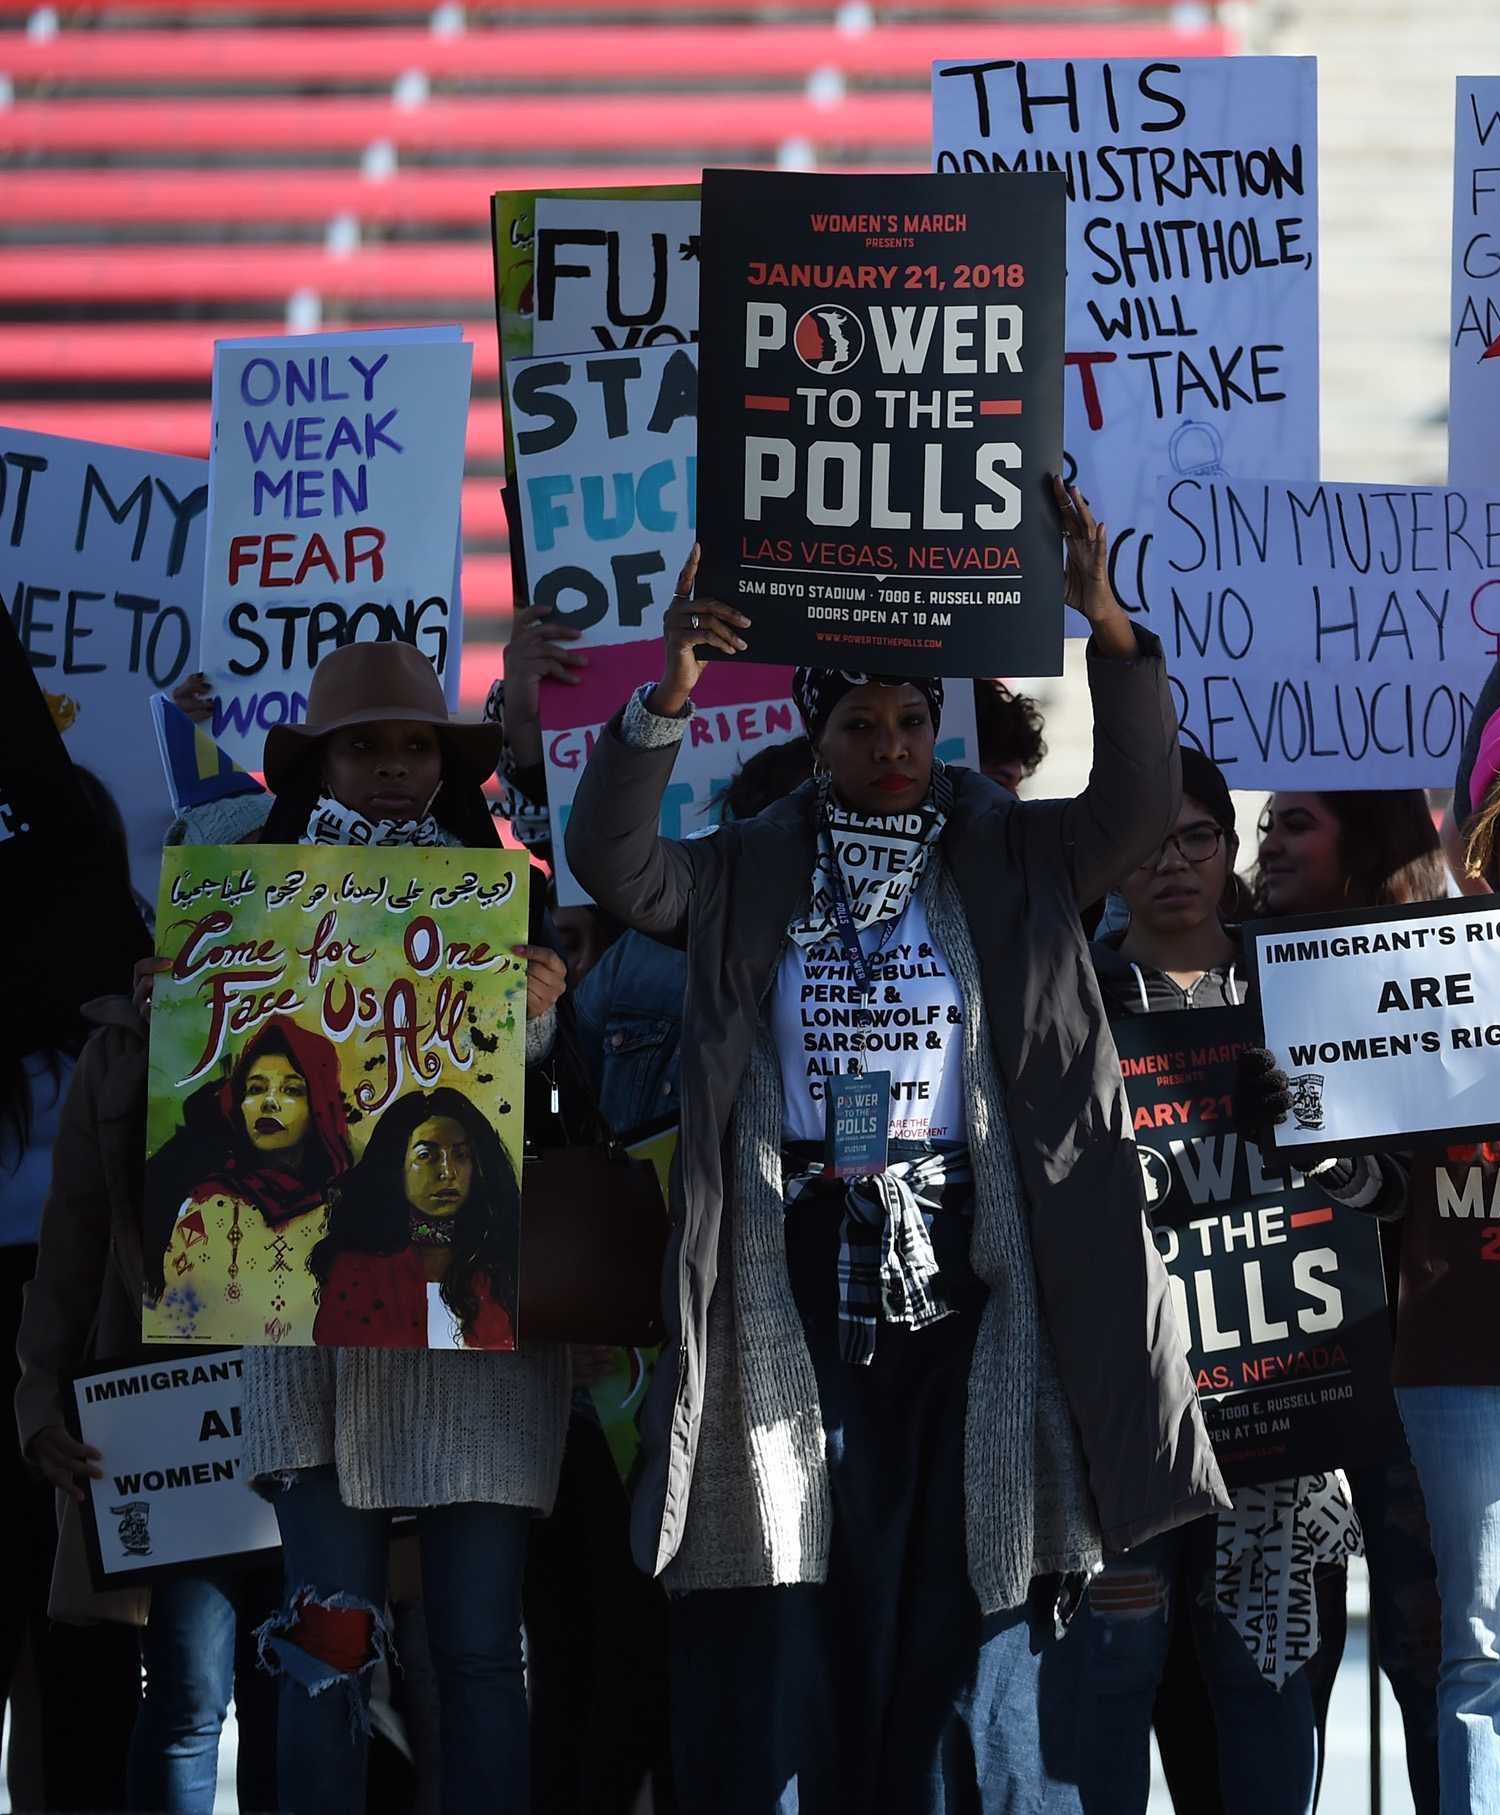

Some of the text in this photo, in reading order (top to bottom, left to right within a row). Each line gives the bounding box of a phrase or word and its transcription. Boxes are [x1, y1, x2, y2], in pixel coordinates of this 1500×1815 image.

[939, 60, 1187, 138] THIS
[810, 214, 967, 233] WOMEN'S MARCH
[866, 237, 914, 248] PRESENTS
[1083, 216, 1313, 288] SHITHOLE,
[747, 262, 1025, 291] JANUARY 21, 2018
[1087, 294, 1198, 341] WILL
[240, 353, 389, 407] ONLY
[1128, 345, 1286, 418] TAKE
[796, 387, 974, 429] TO THE
[243, 409, 404, 463] WEAK
[253, 464, 368, 519] MEN
[744, 435, 1023, 531] POLLS
[75, 464, 208, 577] MY
[1167, 479, 1270, 572] SIN
[228, 526, 386, 587] FEAR
[742, 537, 1020, 570] LAS VEGAS, NEVADA
[739, 580, 1021, 605] SAM BOYD STADIUM 7000 E. RUSSELL ROAD
[227, 596, 449, 677] STRONG
[807, 606, 951, 626] DOORS OPEN AT 10 AM
[1172, 586, 1450, 663] NO HAY
[168, 910, 286, 985] Come
[297, 910, 377, 985] for
[1264, 925, 1457, 965] IMMIGRANT'S
[883, 986, 903, 1003] &
[946, 1005, 963, 1025] &
[1376, 973, 1475, 1015] ARE
[175, 965, 475, 1112] Face Us All
[803, 1031, 942, 1052] SARSOUR &
[1288, 1031, 1442, 1068] WOMEN'S
[805, 1056, 840, 1077] ALI
[1120, 1051, 1185, 1078] OMEN'S
[1188, 1205, 1288, 1258] THE
[1242, 1343, 1349, 1386] NEVADA
